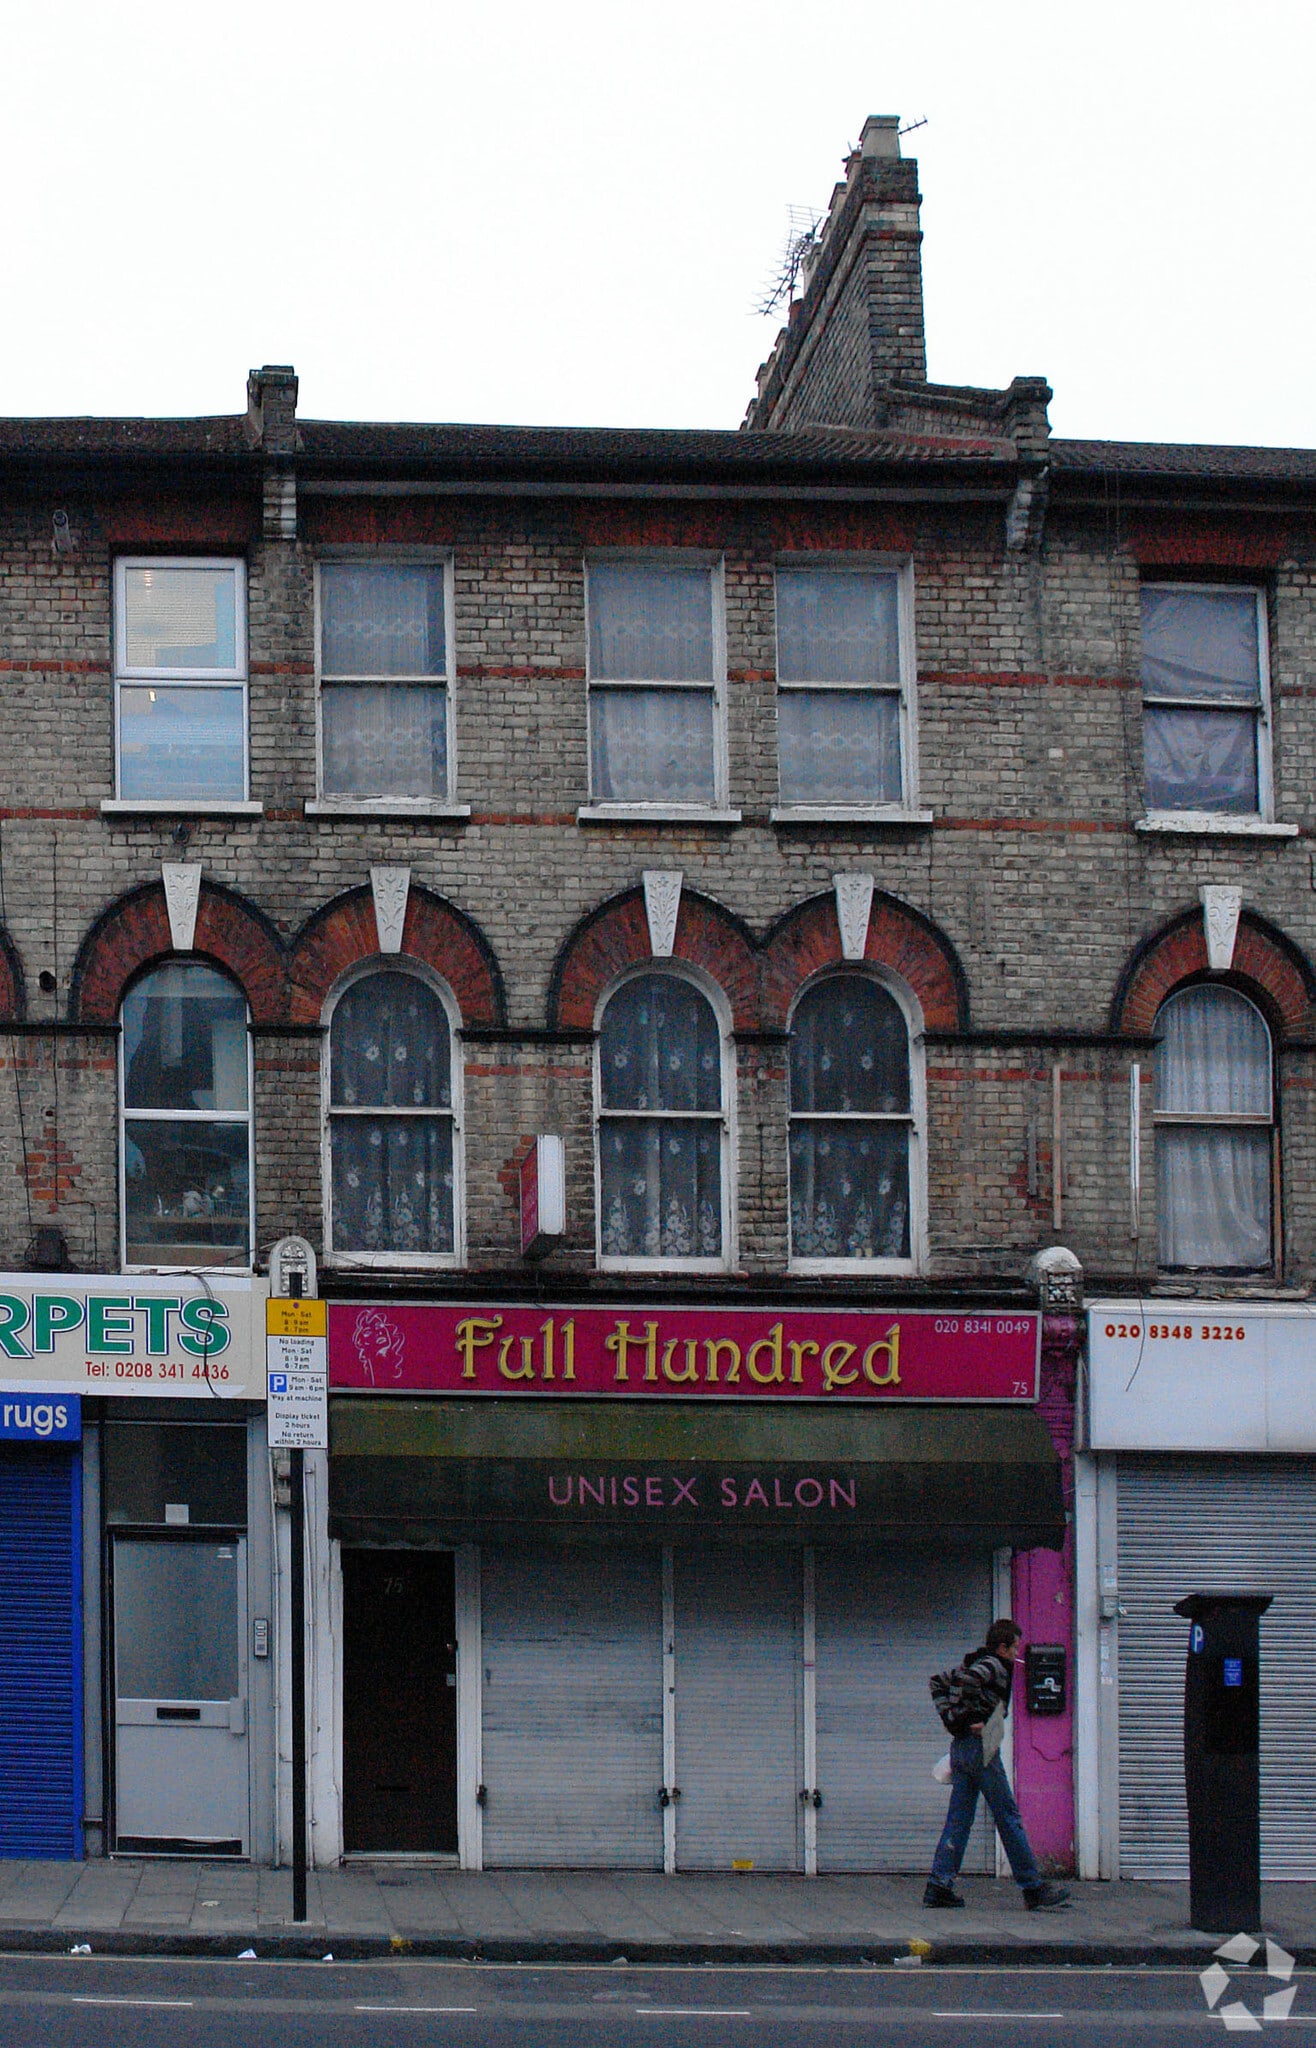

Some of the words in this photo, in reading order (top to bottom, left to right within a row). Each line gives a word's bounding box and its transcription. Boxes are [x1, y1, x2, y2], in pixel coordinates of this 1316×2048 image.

[935, 1320, 958, 1333] 020
[964, 1321, 991, 1333] 8341
[996, 1321, 1030, 1334] 0049
[1105, 1324, 1140, 1338] 020
[1149, 1325, 1192, 1339] 8348
[1201, 1326, 1245, 1339] 3226
[454, 1314, 576, 1380] Full
[604, 1320, 902, 1391] Hundred
[85, 1361, 110, 1377] Tel:
[115, 1362, 152, 1378] 0208
[158, 1363, 184, 1378] 341
[192, 1364, 229, 1380] 4436
[1013, 1382, 1027, 1395] 75
[4, 1402, 68, 1435] rugs
[549, 1476, 699, 1505] UNISEX
[721, 1478, 856, 1507] SALON
